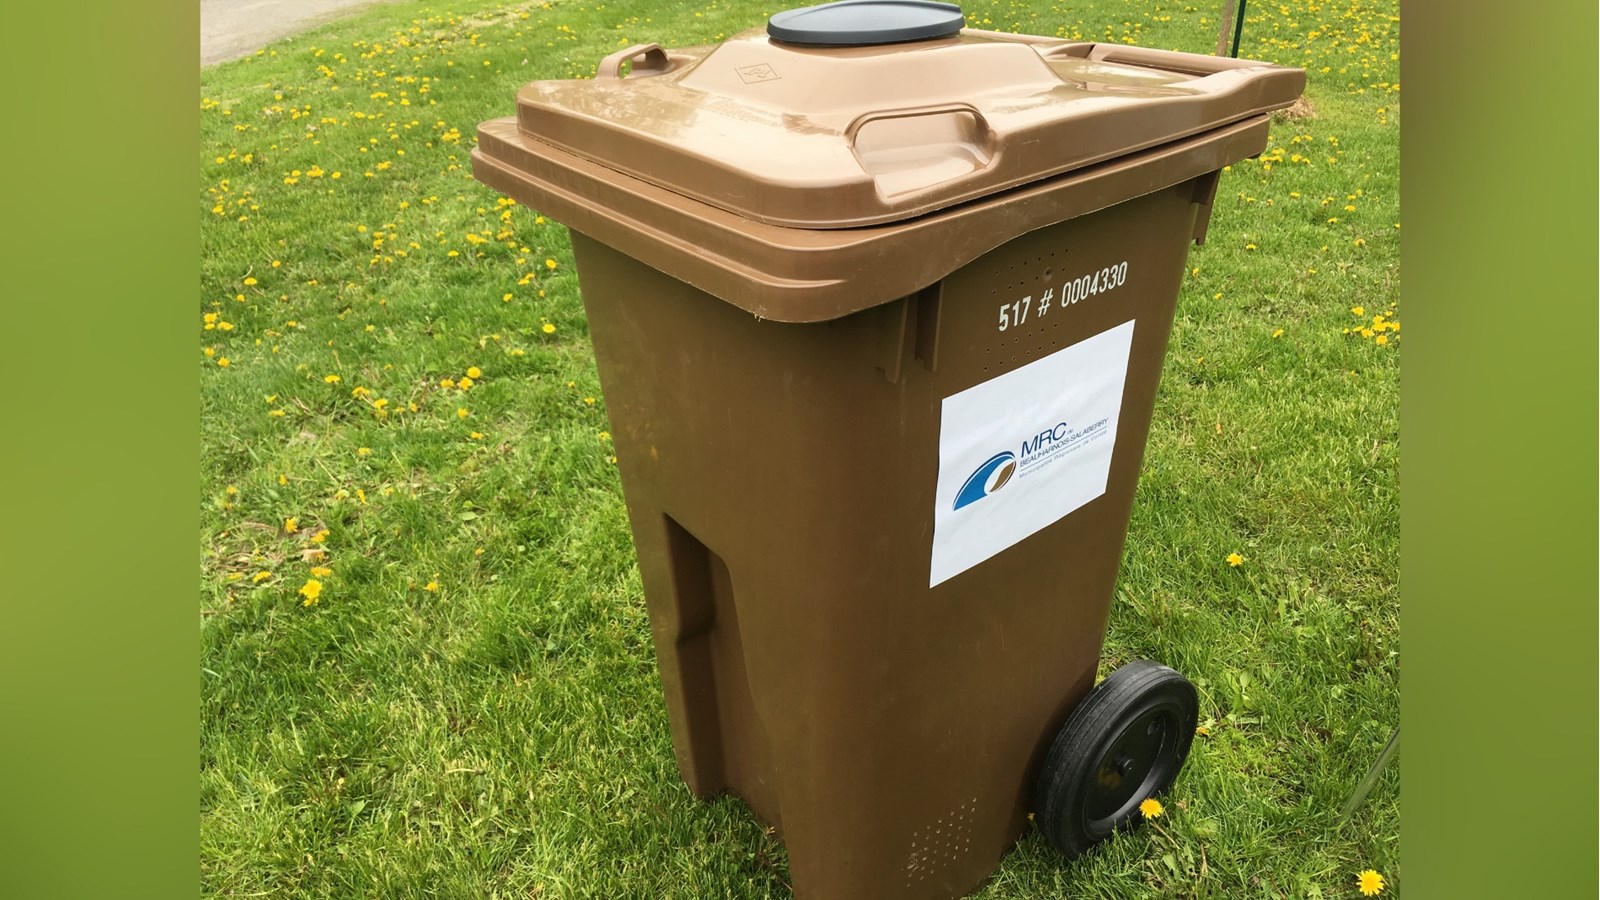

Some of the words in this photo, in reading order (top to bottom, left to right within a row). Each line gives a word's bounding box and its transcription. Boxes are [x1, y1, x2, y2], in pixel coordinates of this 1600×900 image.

[999, 296, 1031, 332] 517
[1038, 288, 1053, 318] #
[1061, 261, 1128, 308] 0004330
[1020, 417, 1109, 468] BEAUHARNOIS-SALABERRY
[1021, 422, 1067, 458] MRC
